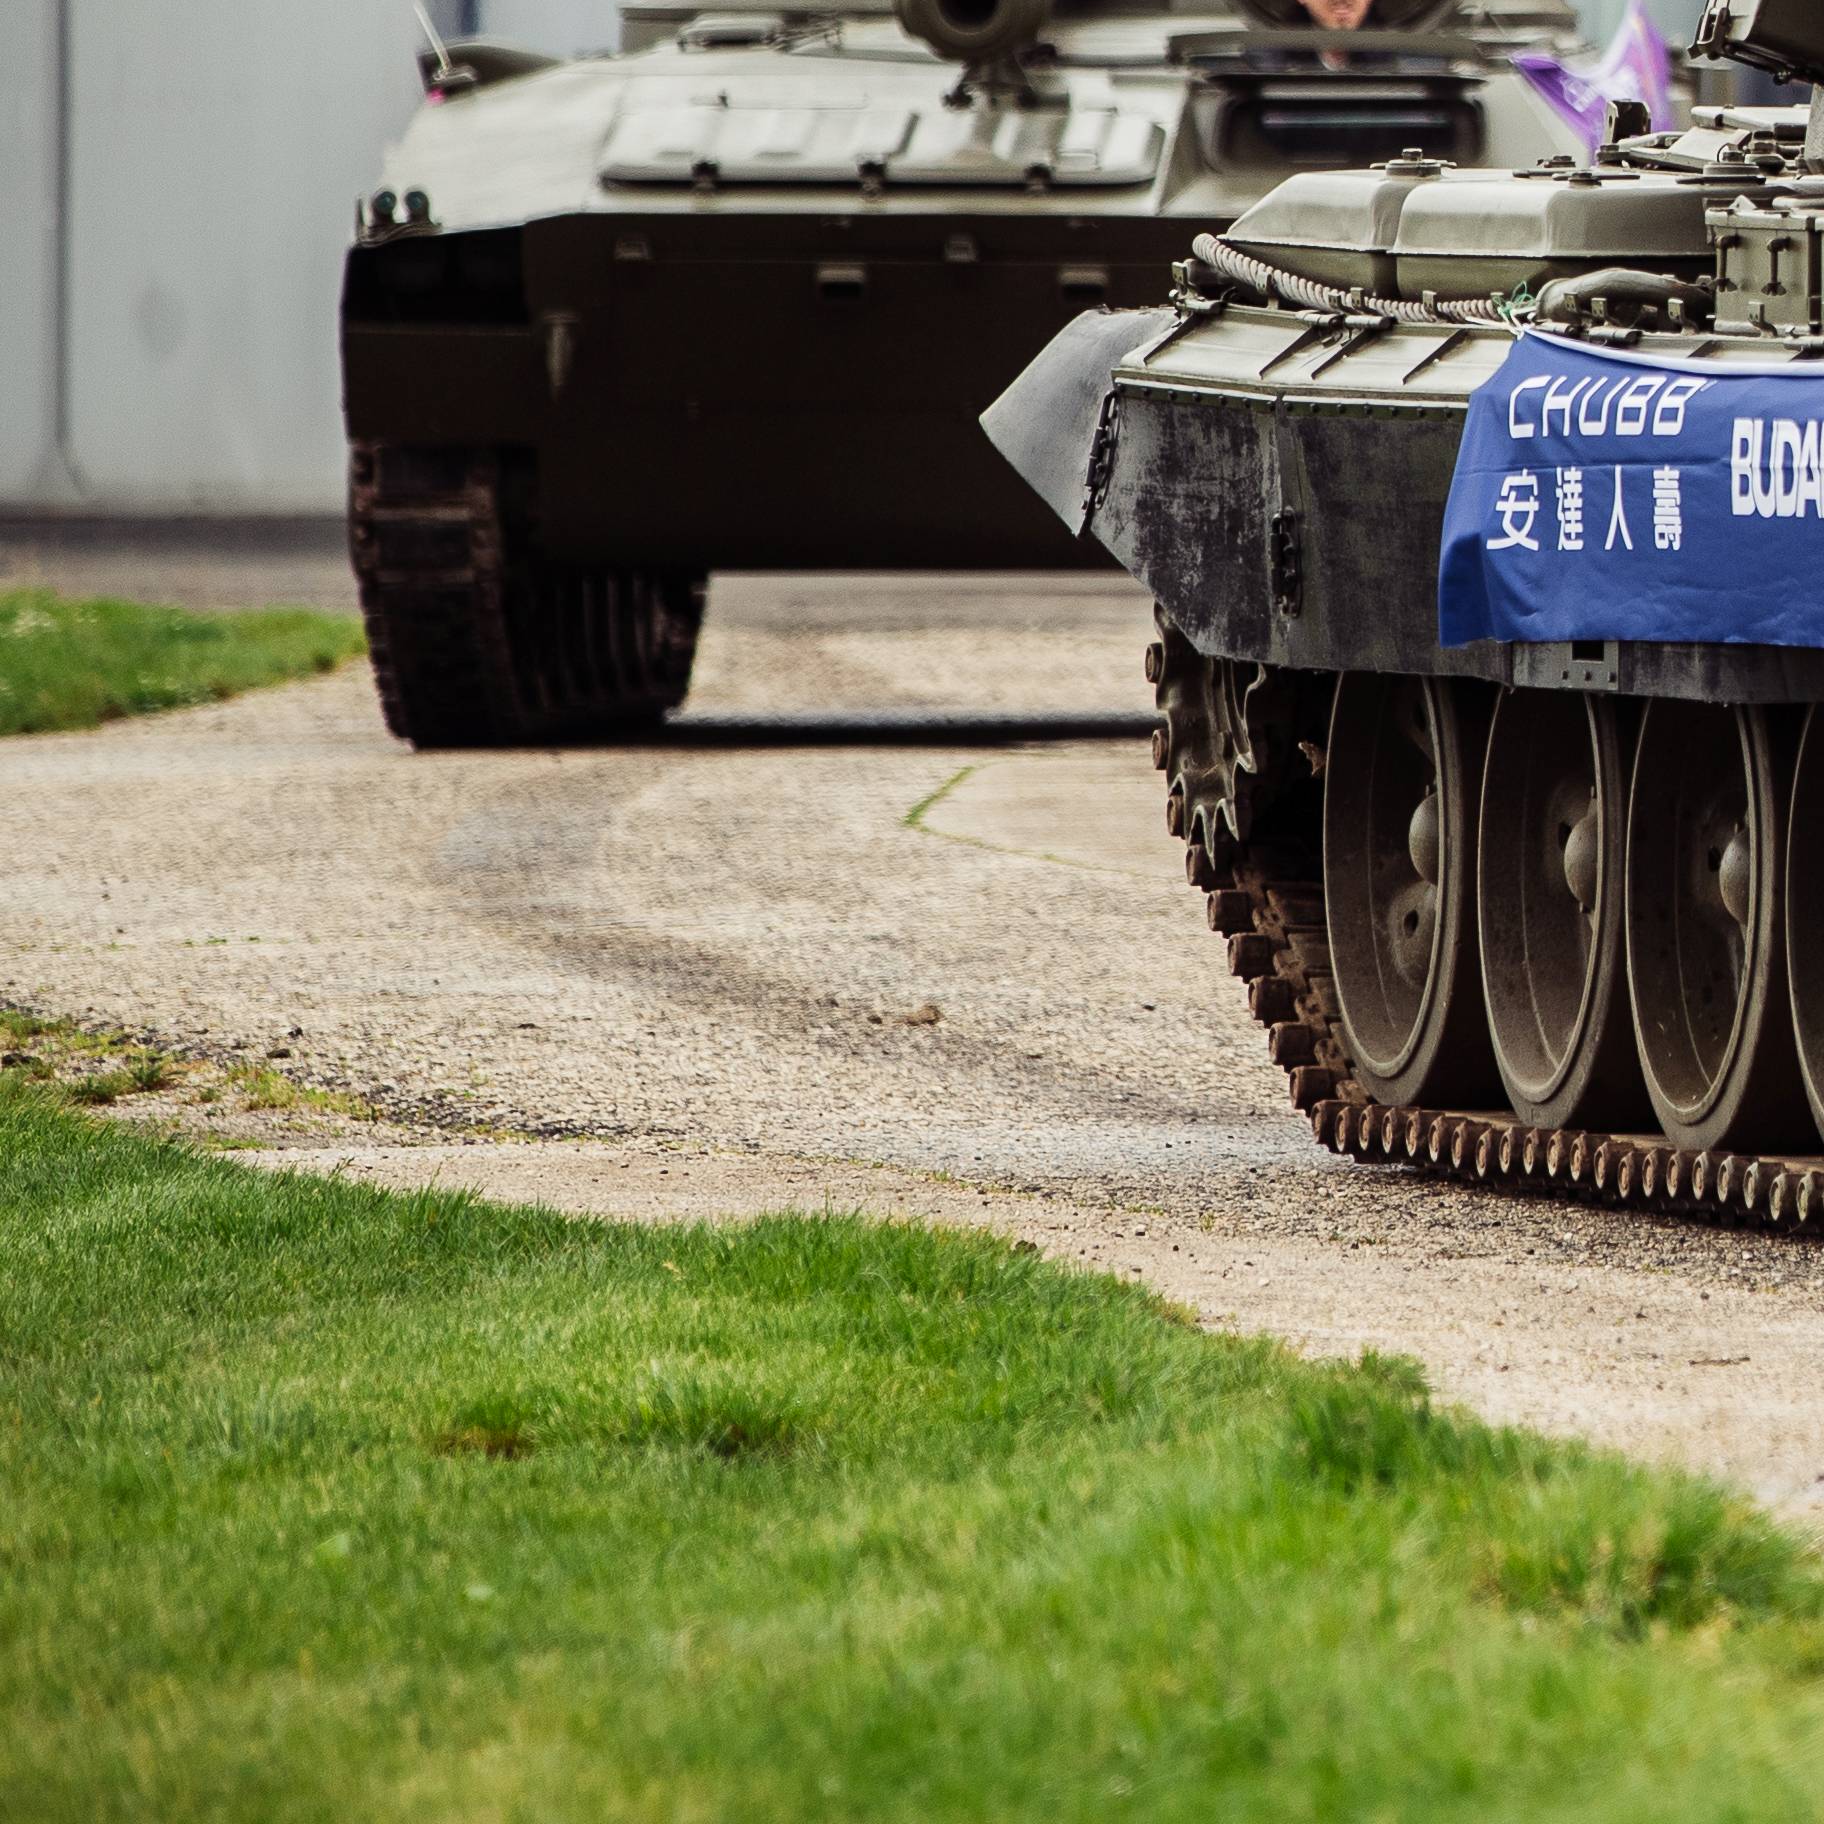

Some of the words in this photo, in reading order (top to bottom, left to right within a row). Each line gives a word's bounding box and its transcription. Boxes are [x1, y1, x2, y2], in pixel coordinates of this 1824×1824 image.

[1508, 375, 1708, 439] CHUBB
[1485, 464, 1683, 552] 安達人壽
